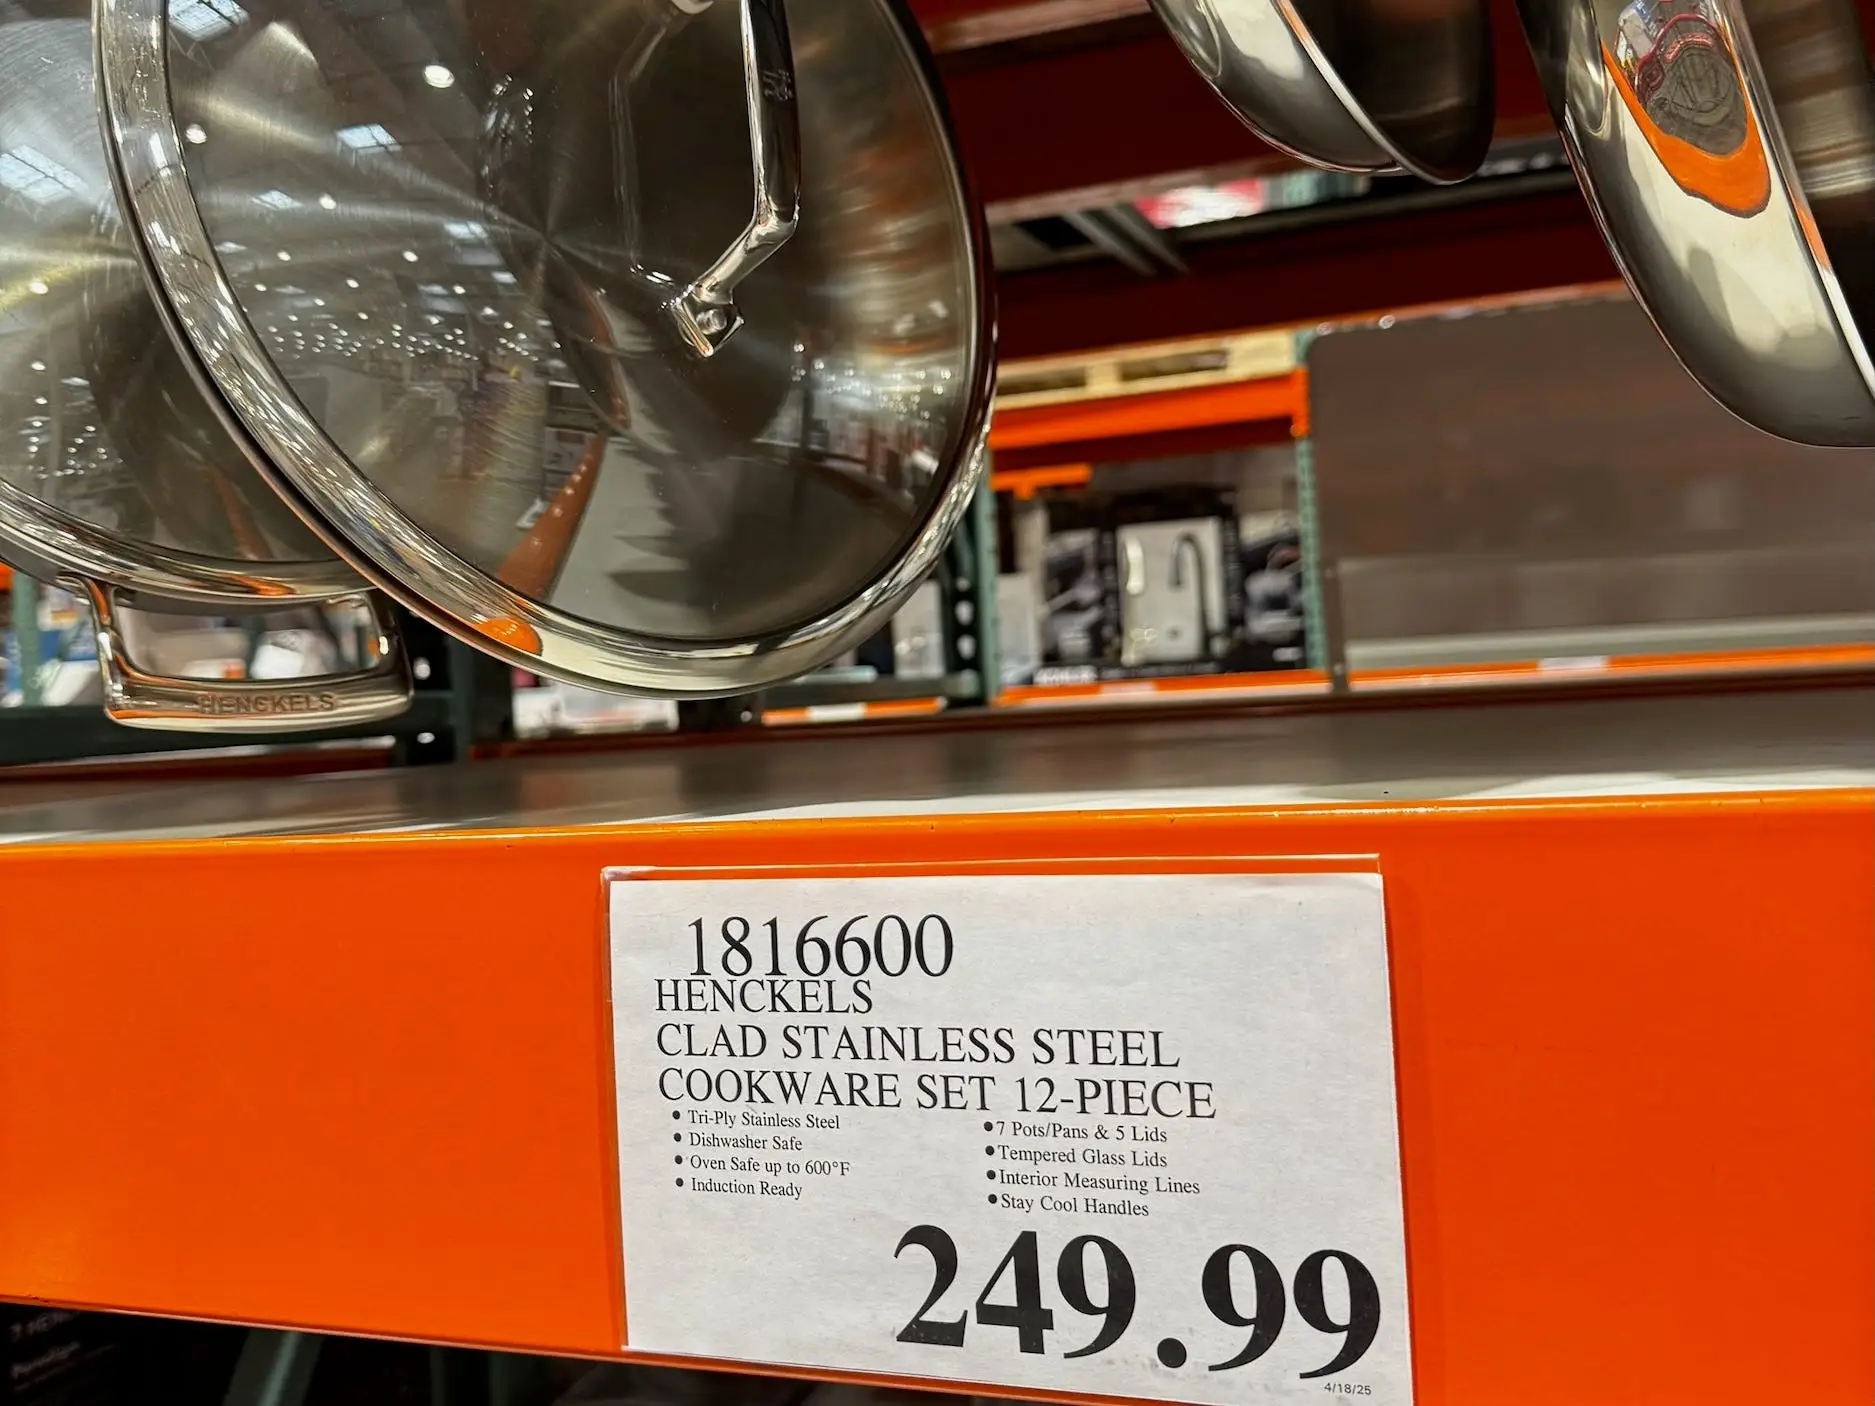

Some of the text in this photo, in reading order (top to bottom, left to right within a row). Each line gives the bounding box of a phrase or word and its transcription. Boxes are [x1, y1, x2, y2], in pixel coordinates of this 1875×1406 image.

[197, 692, 336, 714] HENCKELS
[687, 914, 954, 978] 1816600
[654, 978, 873, 1014] HENCKELS
[656, 1023, 1180, 1067] CLAD STAINLESS STEEL
[658, 1067, 1217, 1119] COOKWARE SET 12-PIECE
[687, 1109, 840, 1130] Tri-Ply Stainless Steel
[689, 1132, 803, 1151] Dishwasher Safe
[996, 1121, 1168, 1143] 7 Pots/Pans & 5 Lids
[690, 1155, 850, 1177] Oven Safe up to 600°F
[997, 1144, 1168, 1168] Tempered Glass Lids
[691, 1178, 802, 1200] Induction Ready
[999, 1169, 1201, 1196] Interior Measuring Lines
[1000, 1193, 1150, 1216] Stay Cool Handles
[893, 1224, 1381, 1379] 249.99
[1324, 1381, 1373, 1397] 4/18/25
